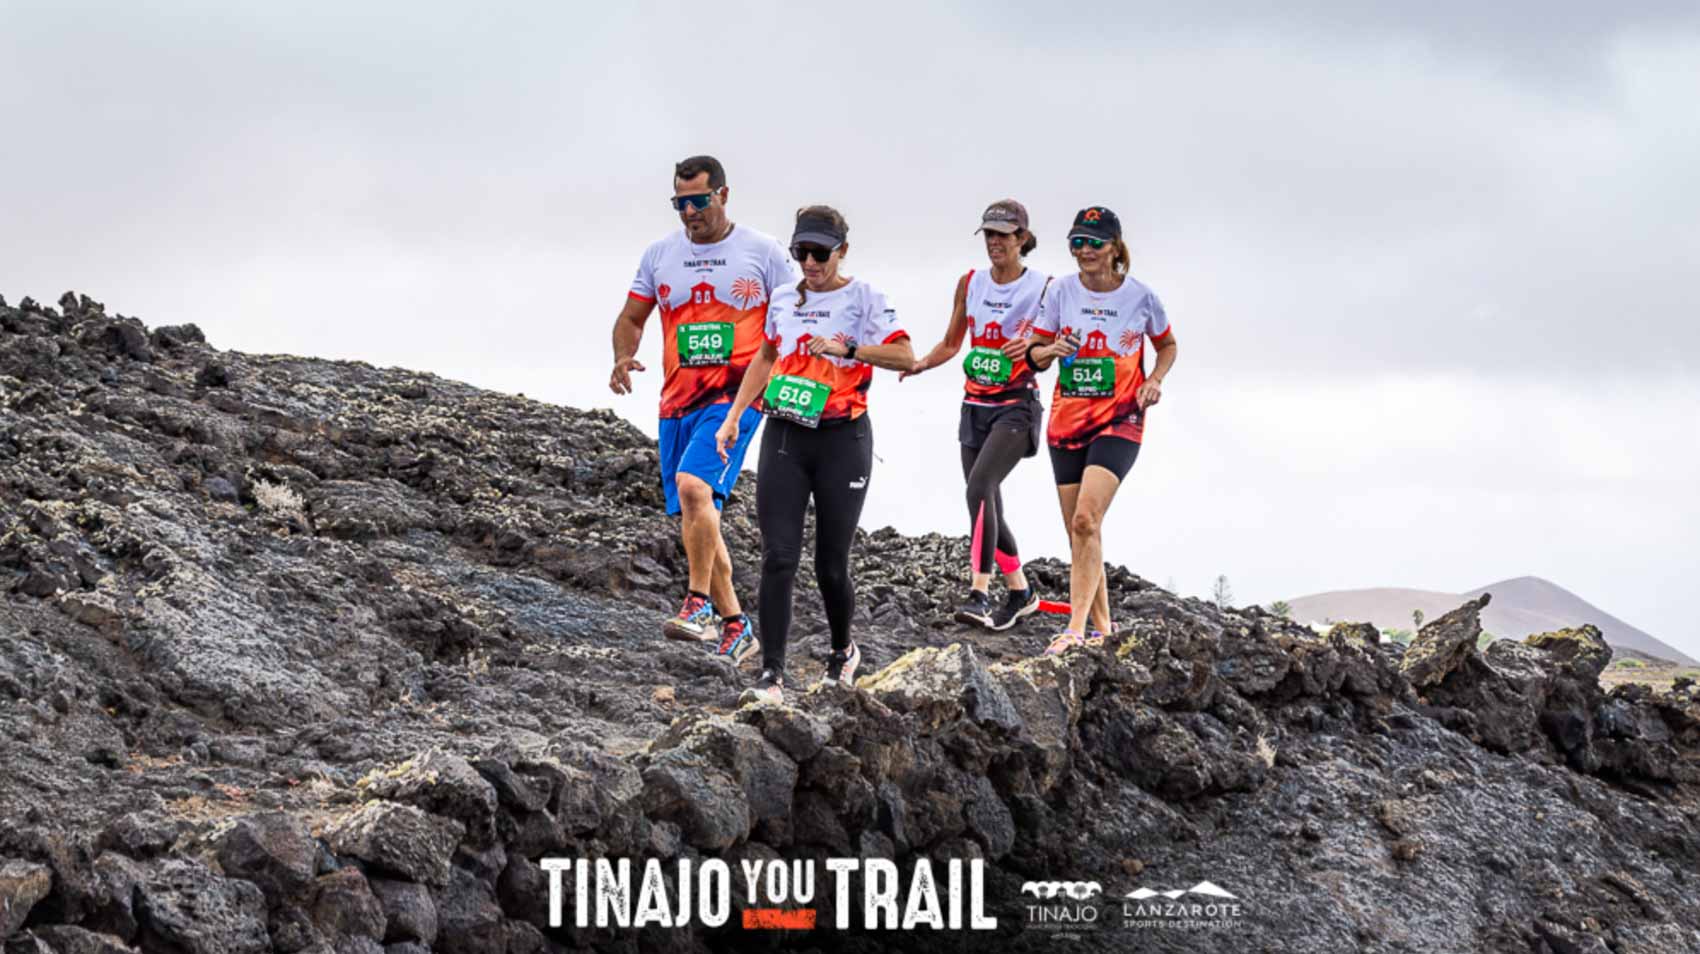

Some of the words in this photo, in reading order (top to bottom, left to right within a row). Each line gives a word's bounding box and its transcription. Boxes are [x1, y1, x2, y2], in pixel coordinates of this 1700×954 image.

[688, 333, 723, 350] 549
[971, 355, 1001, 373] 648
[1072, 367, 1104, 383] 514
[778, 385, 813, 407] 516
